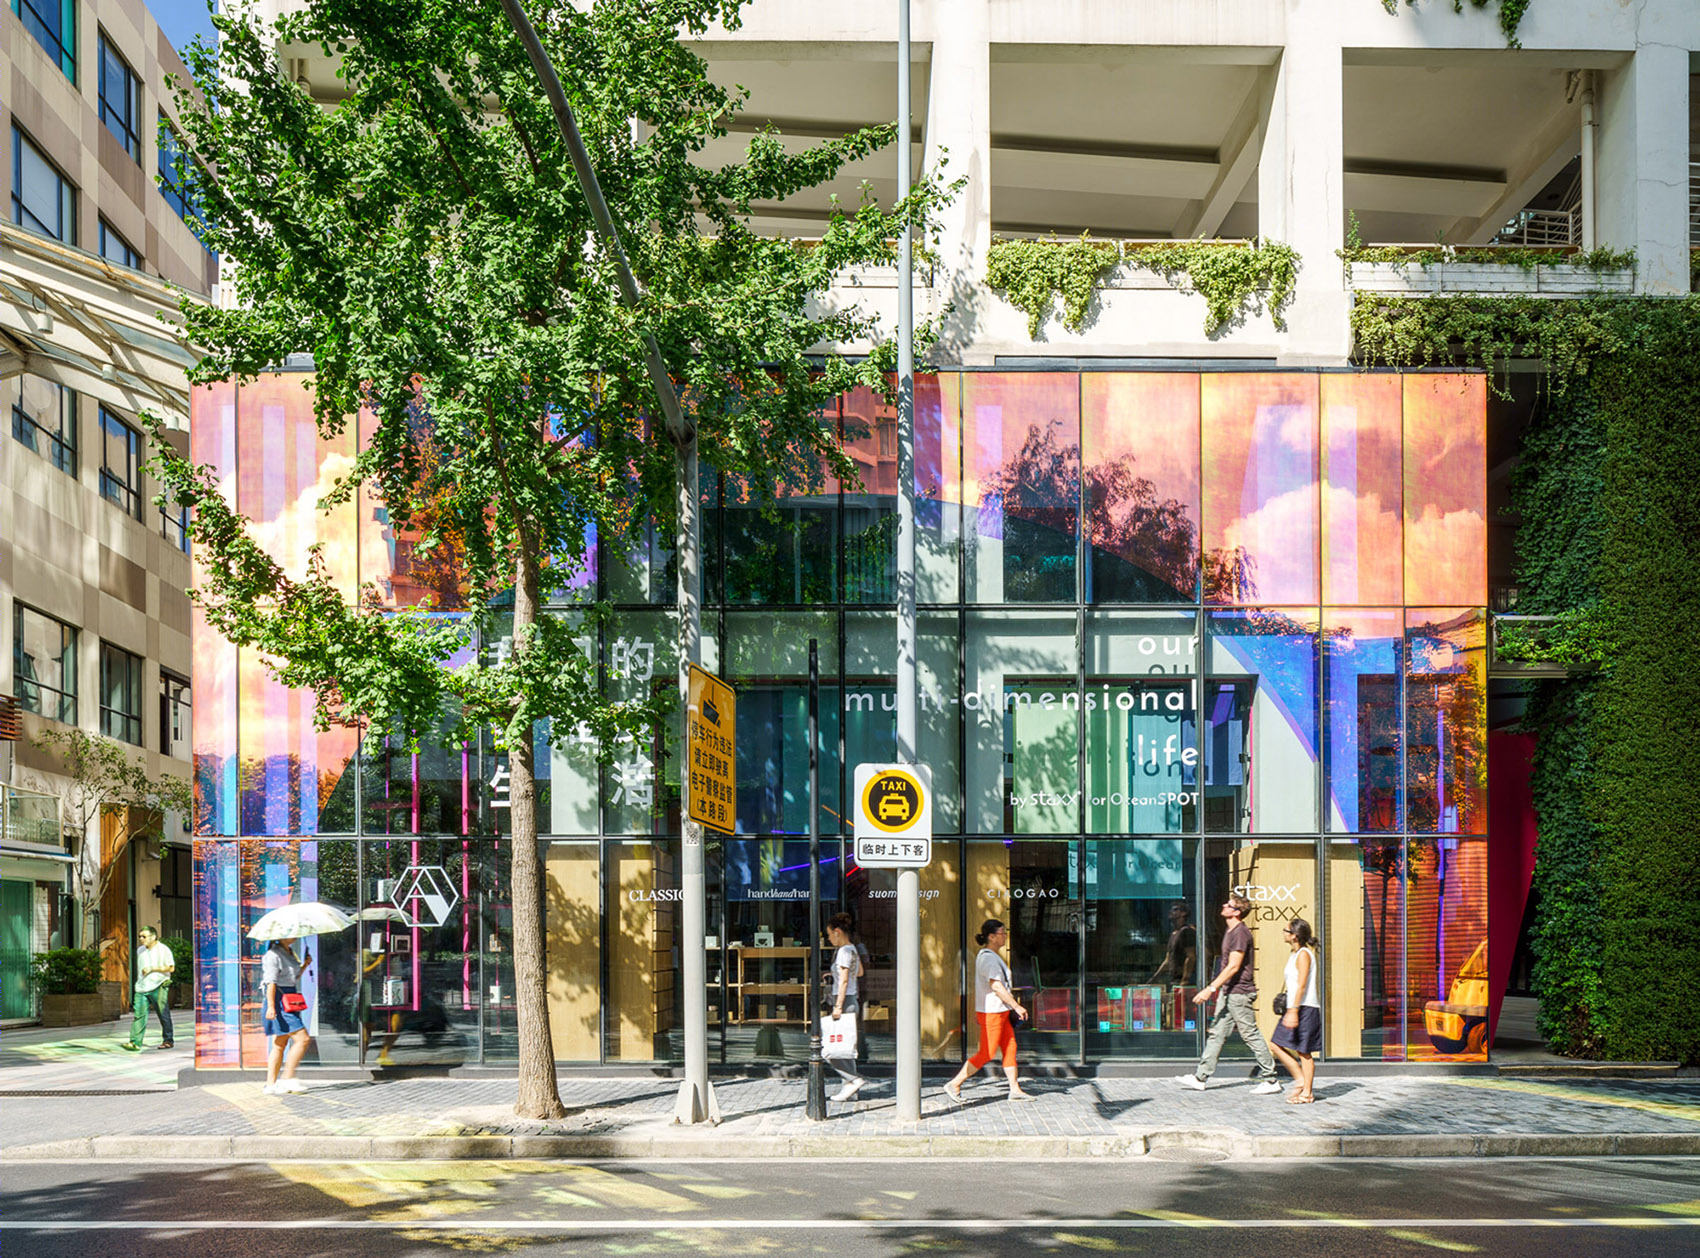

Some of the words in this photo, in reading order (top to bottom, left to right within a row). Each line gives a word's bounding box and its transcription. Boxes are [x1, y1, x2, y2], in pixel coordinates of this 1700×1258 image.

[1138, 636, 1199, 656] our
[845, 678, 1197, 712] muti-dimensional
[1137, 734, 1199, 766] life
[880, 781, 906, 791] TAXI
[1010, 791, 1027, 809] by
[1087, 792, 1106, 806] or
[862, 843, 924, 856] 临时上下客
[868, 889, 898, 899] suom
[918, 889, 940, 901] sign
[986, 888, 1059, 899] CIAOGAO
